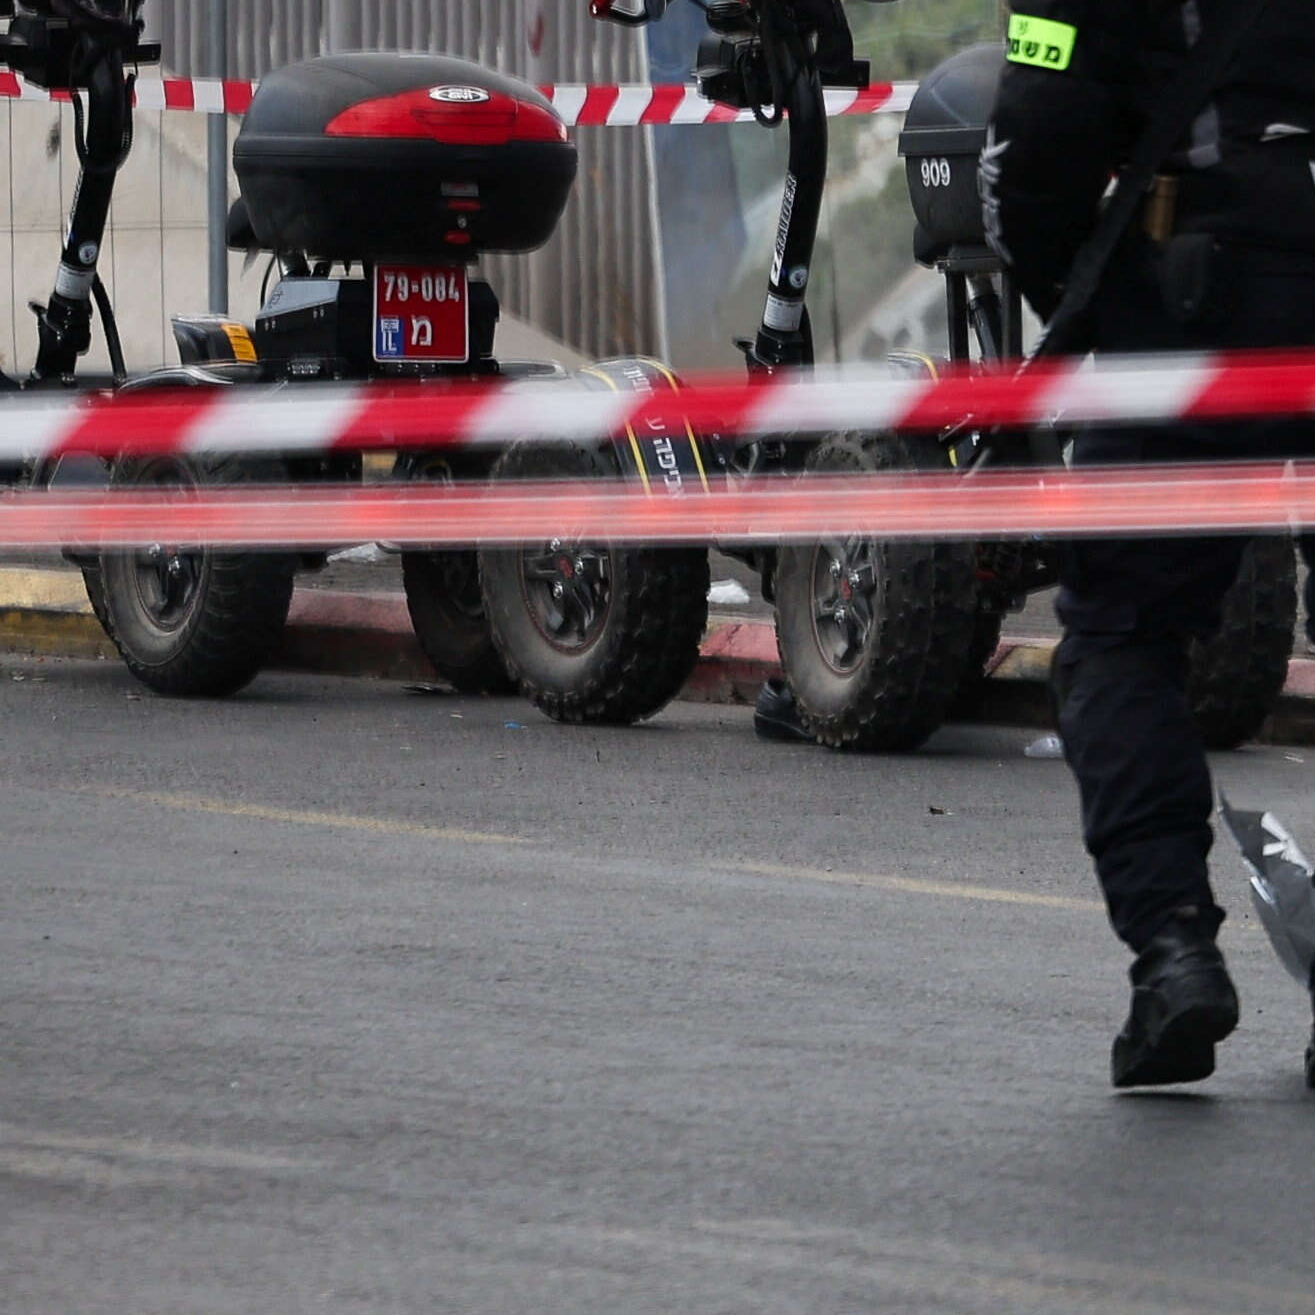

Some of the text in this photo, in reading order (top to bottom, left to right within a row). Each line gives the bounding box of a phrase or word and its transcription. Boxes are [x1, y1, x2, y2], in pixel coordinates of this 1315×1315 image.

[920, 157, 951, 188] 909
[383, 271, 460, 303] 79-084
[411, 314, 433, 347] מ
